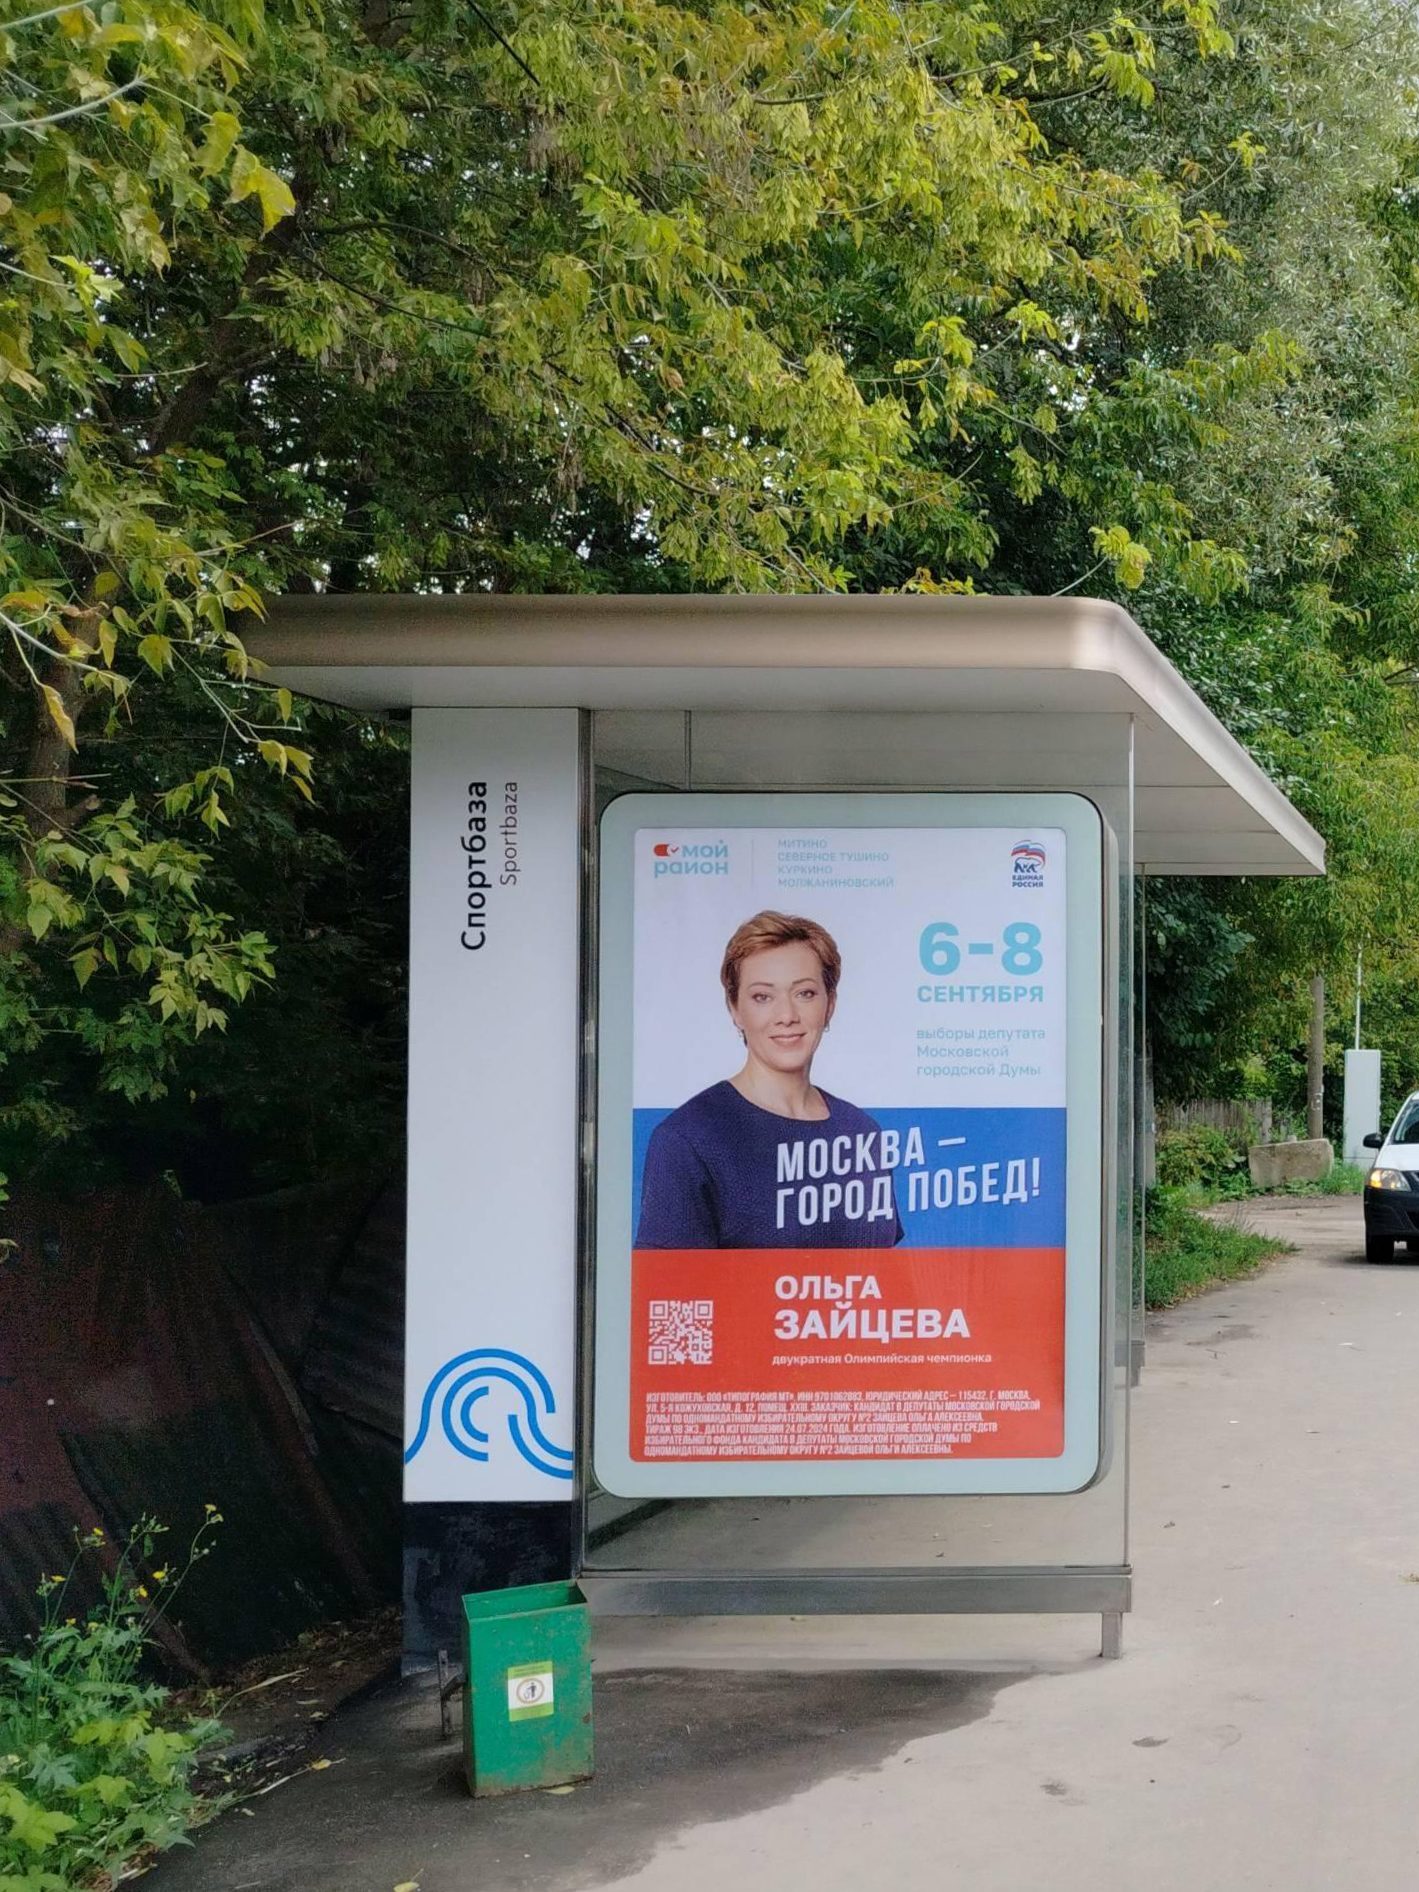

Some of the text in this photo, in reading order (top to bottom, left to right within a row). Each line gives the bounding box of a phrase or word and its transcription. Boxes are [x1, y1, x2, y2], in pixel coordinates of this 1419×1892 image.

[499, 782, 520, 886] Sportbaza
[682, 840, 728, 858] мой
[778, 839, 828, 848] МИТИНО
[778, 852, 889, 862] СЕВЕРНОЕ ТУШИНО
[461, 781, 492, 950] Спортбаза
[778, 865, 832, 874] КУРКИНО
[778, 876, 894, 888] МОЛЖАНИНОВСКИЙ
[917, 985, 1044, 1003] СЕНТЯБРЯ
[917, 1027, 1046, 1042] выборы депутата
[917, 1044, 1009, 1058] Московской
[917, 1063, 1041, 1078] городской Думы
[776, 1126, 926, 1183] МОСКВА
[776, 1157, 1041, 1230] ГОРОД ПОБЕД!
[774, 1275, 882, 1300] ОЛЬГА
[774, 1301, 971, 1344] ЗАЙЦЕВА
[772, 1352, 992, 1366] двукратная Олимпийская чемпионка
[707, 1392, 721, 1402] ООО
[797, 1391, 813, 1401] ИНН
[865, 1390, 923, 1401] ЮРИДИЧЕСКИЙ
[925, 1391, 949, 1400] АДРЕС
[854, 1401, 894, 1411] КАНДИДАТ
[897, 1401, 902, 1411] В
[903, 1401, 944, 1411] ДЕПУТАТЫ
[945, 1400, 994, 1410] МОСКОВСКОЙ
[997, 1400, 1040, 1410] ГОРОДСКОЙ
[646, 1413, 670, 1423] ДУМЫ
[671, 1413, 682, 1423] ПО
[828, 1412, 857, 1422] ОКРУГУ
[908, 1412, 933, 1421] ОЛЬГА
[647, 1424, 671, 1434] ТИРАЖ
[705, 1424, 725, 1433] ДАТА
[853, 1423, 909, 1432] ИЗГОТОВЛЕНИЕ
[912, 1422, 951, 1432] ОПЛАЧЕНО
[952, 1422, 963, 1432] ИЗ
[964, 1422, 997, 1432] СРЕДСТВ
[713, 1434, 741, 1444] ФОНДА
[742, 1434, 788, 1444] КАНДИДАТА
[797, 1434, 837, 1444] ДЕПУТАТЫ
[838, 1433, 889, 1443] МОСКОВСКОЙ
[890, 1433, 934, 1443] ГОРОДСКОЙ
[935, 1433, 959, 1443] ДУМЫ
[961, 1433, 971, 1443] ПО
[789, 1444, 818, 1454] ОКРУГУ
[875, 1444, 900, 1454] ОЛЬГИ
